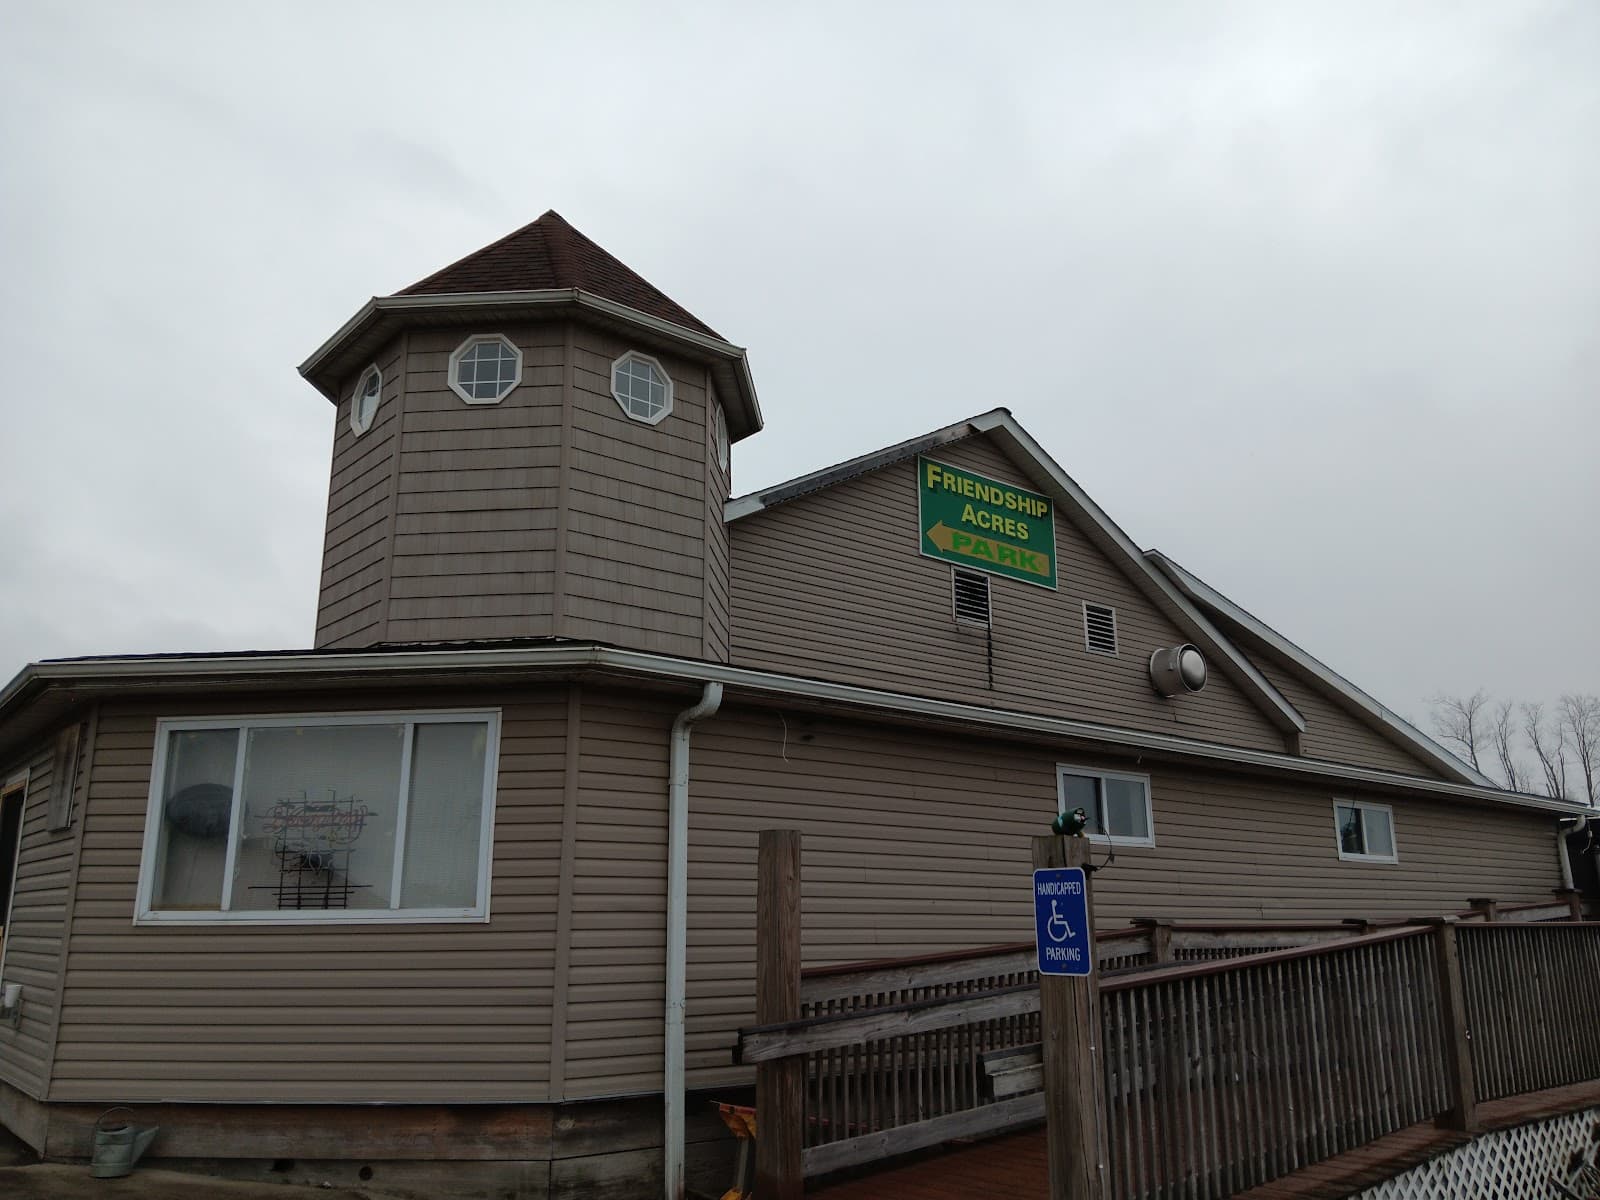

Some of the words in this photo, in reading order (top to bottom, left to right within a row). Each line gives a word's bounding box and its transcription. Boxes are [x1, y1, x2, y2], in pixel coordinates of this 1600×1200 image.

[926, 463, 1048, 518] FRIENDSHIP
[961, 503, 1029, 540] ACRES
[951, 531, 1040, 572] PARK
[1037, 881, 1082, 896] HANDICAPPED
[1045, 946, 1081, 962] PARKING
